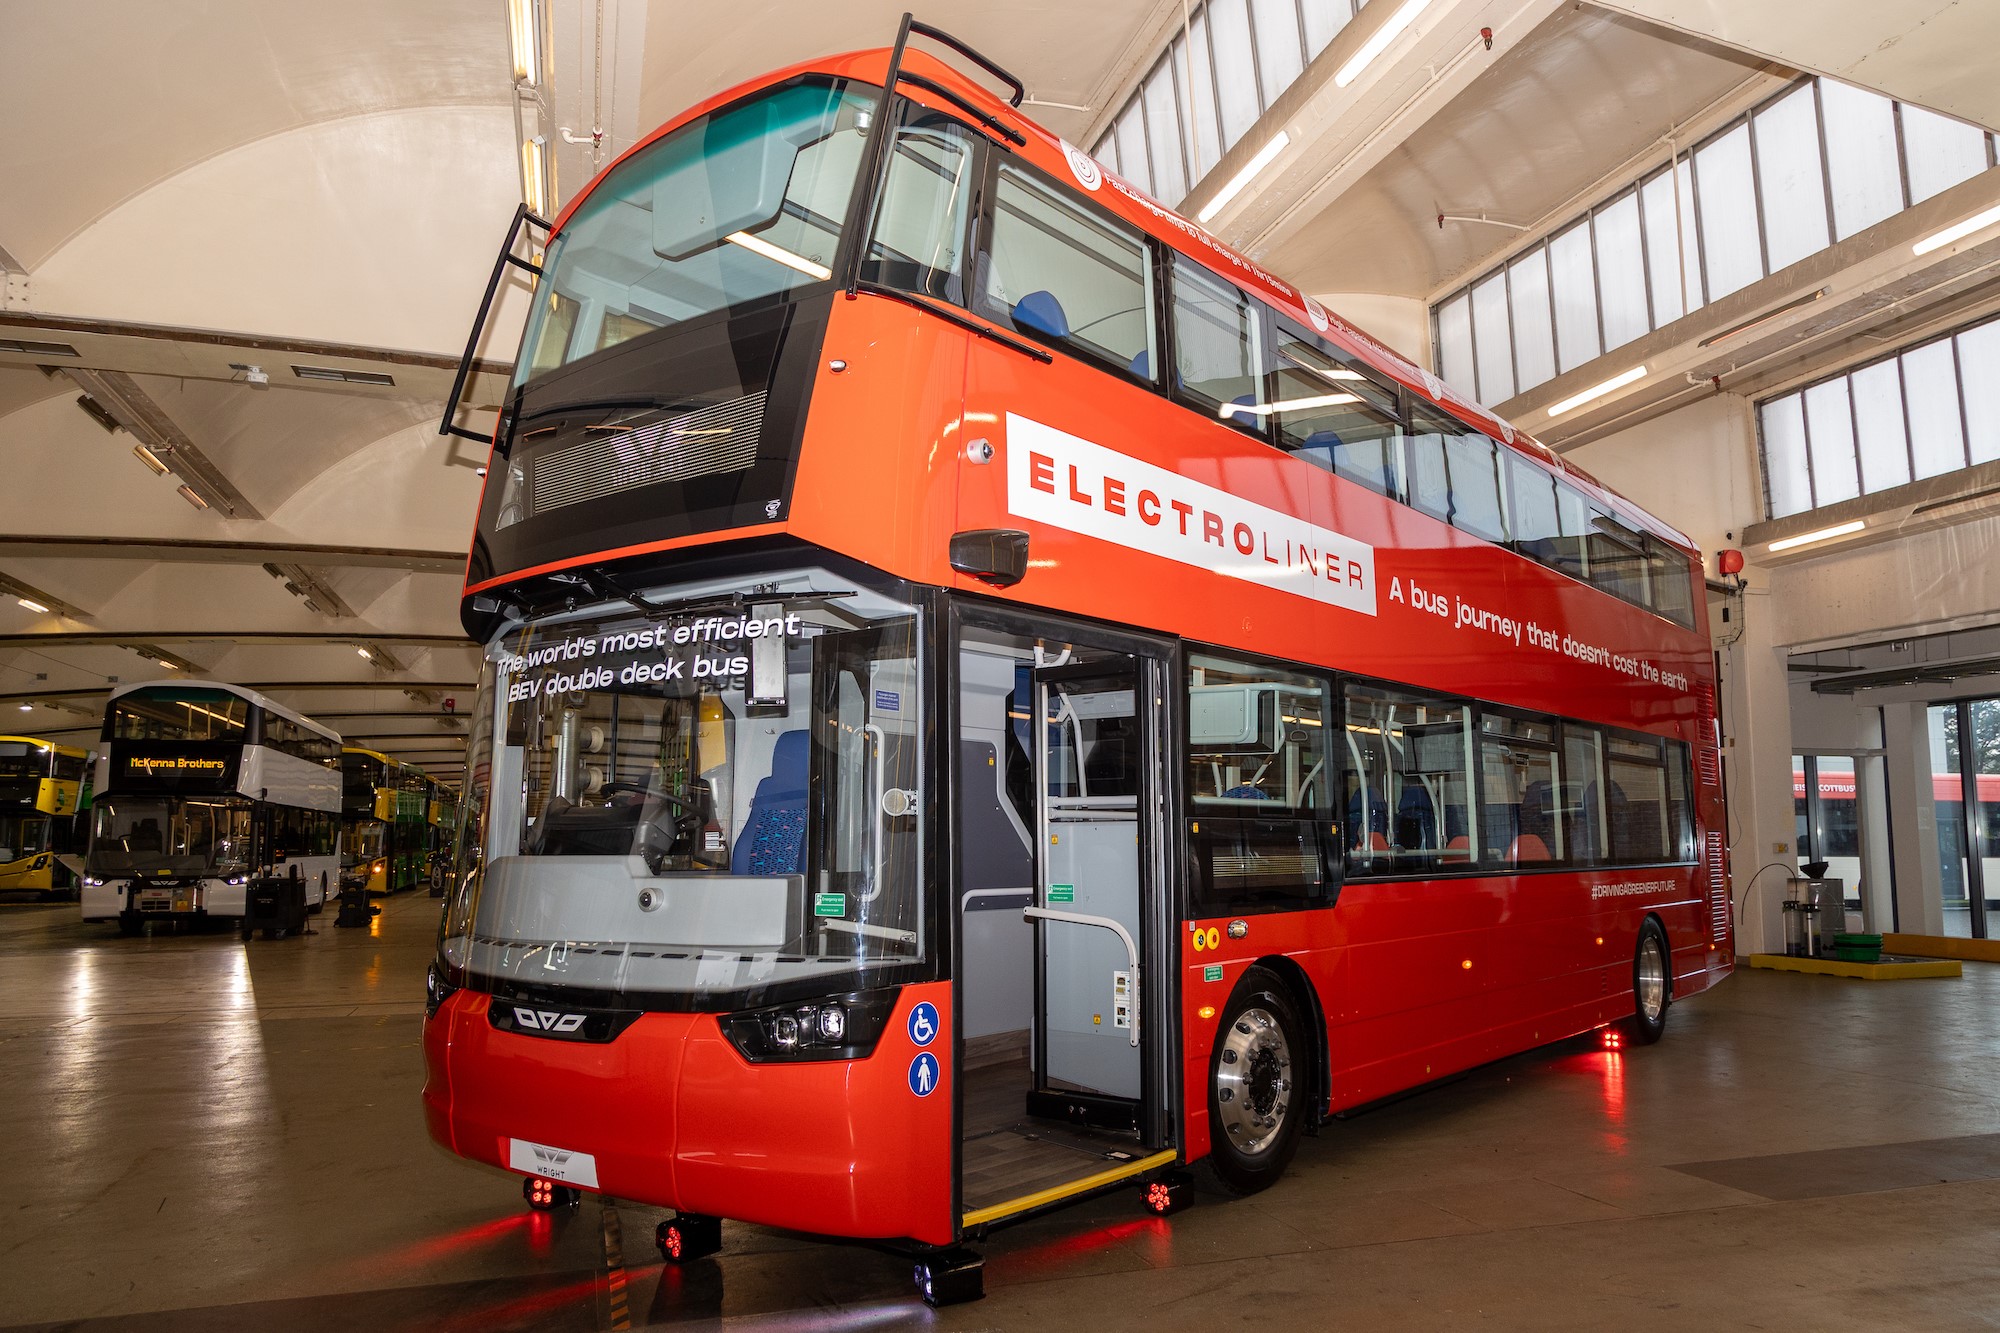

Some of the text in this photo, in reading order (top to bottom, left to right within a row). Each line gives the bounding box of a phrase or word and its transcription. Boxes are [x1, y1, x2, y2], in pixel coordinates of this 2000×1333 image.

[1104, 172, 1127, 196] Fast
[1128, 190, 1165, 217] charge
[1164, 211, 1187, 232] time
[1186, 225, 1197, 239] to
[1196, 230, 1213, 249] full
[1212, 242, 1243, 266] charge
[1240, 259, 1252, 273] in
[1029, 450, 1364, 591] ELECTROLINER
[497, 612, 801, 678] The world's most efficient
[1388, 576, 1688, 692] A bus journey that doesn't cost the earth
[508, 654, 749, 703] BEV double deck bus
[130, 757, 224, 769] McKenna Brothers
[1591, 880, 1676, 900] #DRIVINGAGREENERFUTURE
[537, 1165, 565, 1179] WRIGHT
